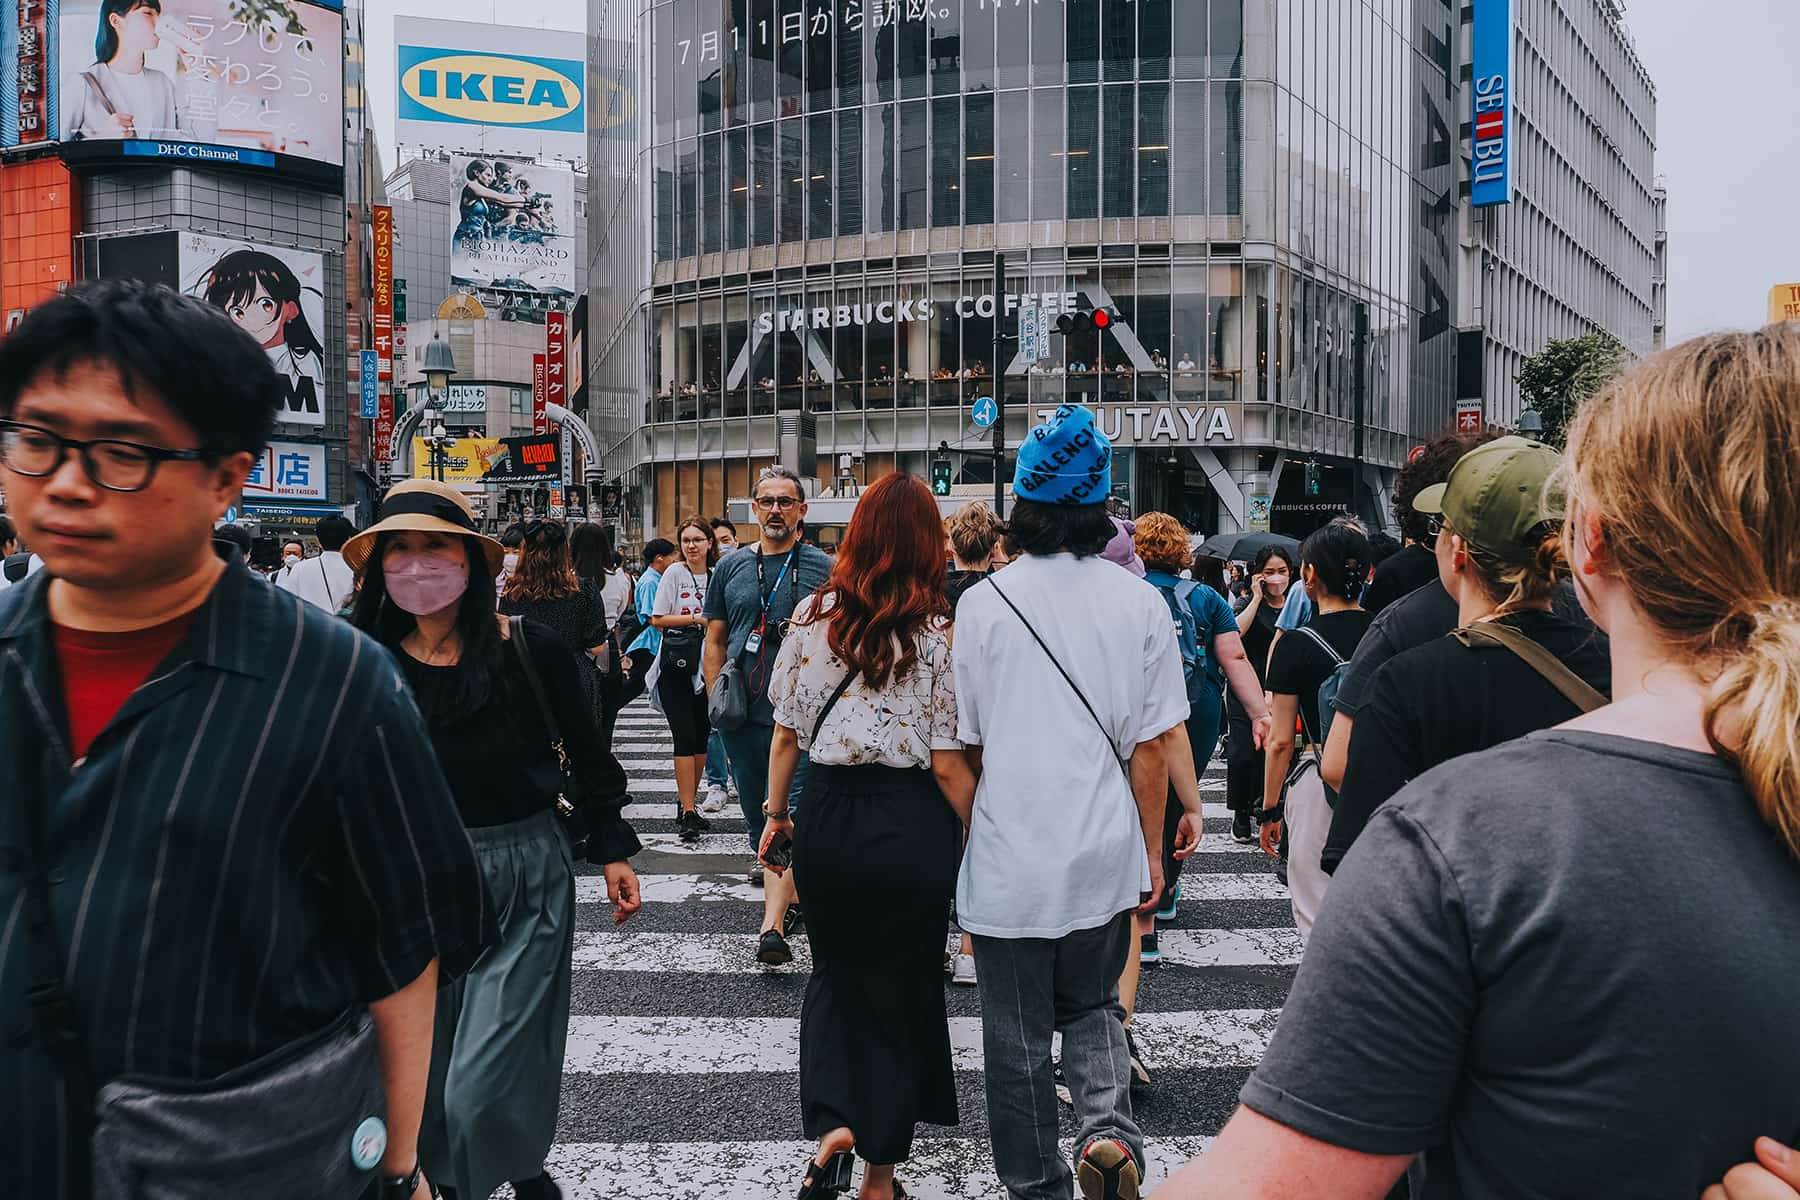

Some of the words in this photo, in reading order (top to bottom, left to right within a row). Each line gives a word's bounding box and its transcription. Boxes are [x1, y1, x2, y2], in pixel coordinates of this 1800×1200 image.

[419, 69, 570, 109] IKEA
[1475, 74, 1504, 185] SEIBU
[158, 143, 187, 156] DHC
[188, 146, 239, 161] Channel
[376, 210, 389, 306] クスリのことなら
[461, 239, 569, 260] BIOHAZARD
[758, 298, 935, 334] STARBUCKS
[955, 291, 1078, 318] COFFEE
[375, 313, 391, 373] 三千里
[548, 321, 563, 395] カラオケ
[1036, 407, 1235, 441] TUTAYA
[1460, 413, 1478, 429] 本
[1271, 503, 1315, 512] TARBUCKS
[1315, 503, 1348, 511] COFFEE
